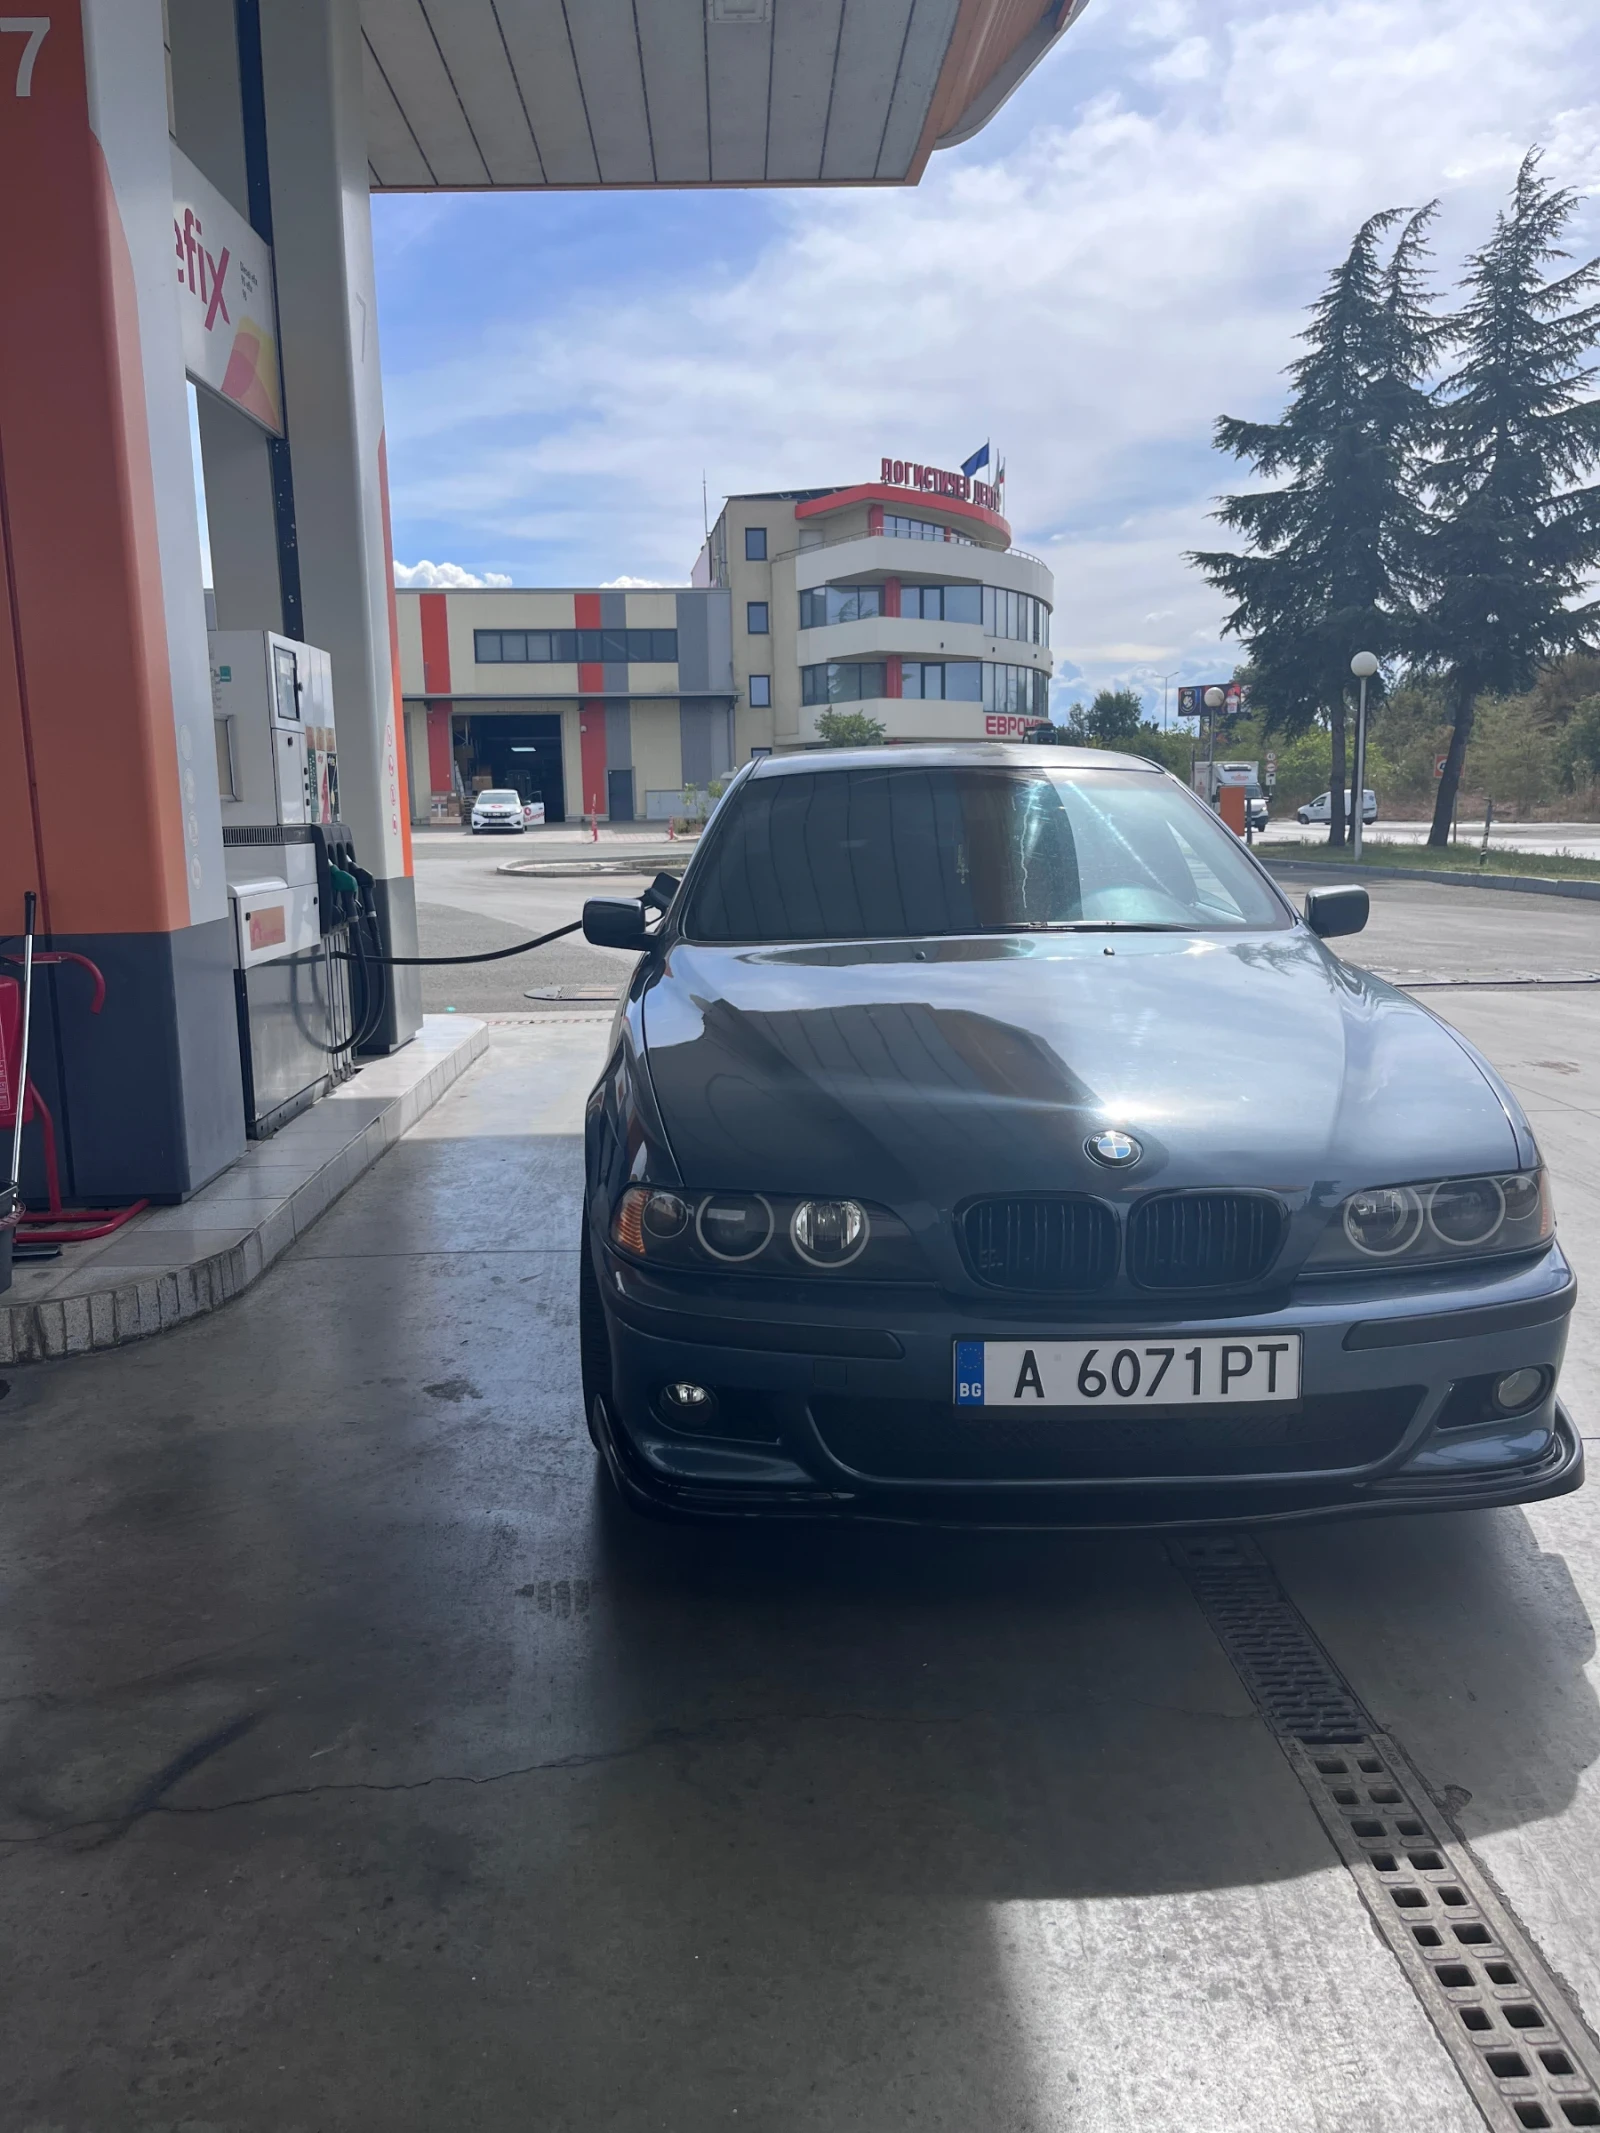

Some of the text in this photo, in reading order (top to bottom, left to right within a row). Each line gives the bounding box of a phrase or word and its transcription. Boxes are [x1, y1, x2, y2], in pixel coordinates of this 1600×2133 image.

[0, 16, 51, 97] 7
[959, 1382, 982, 1398] BG
[1013, 1349, 1045, 1399] A
